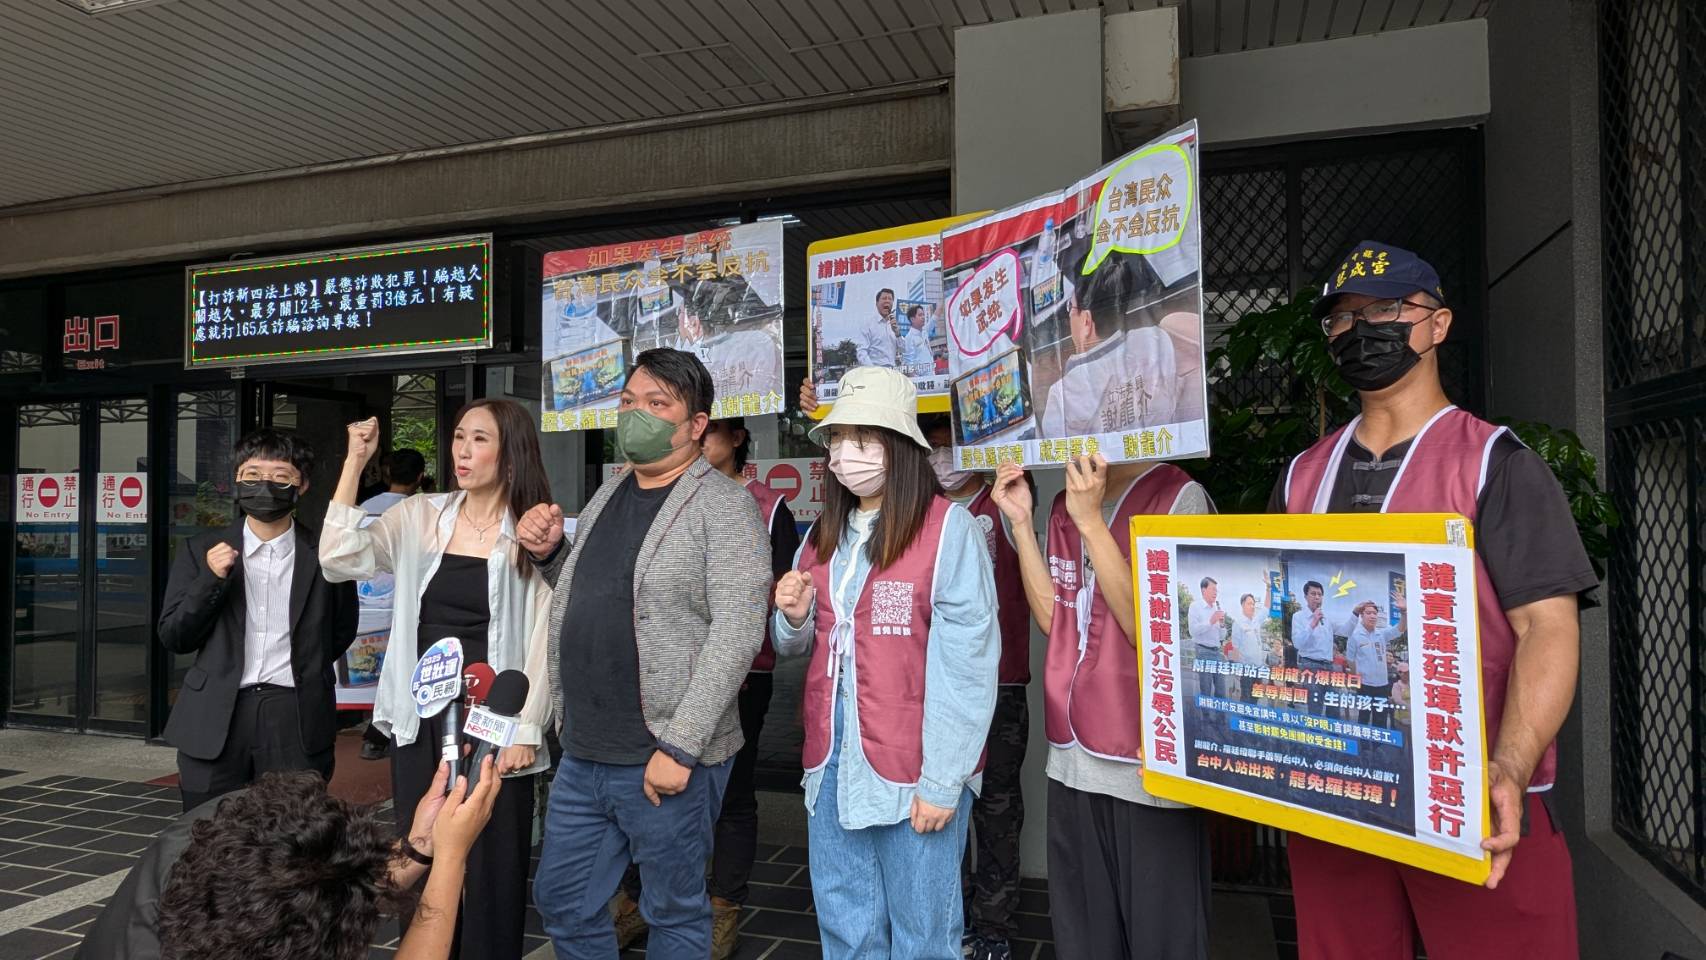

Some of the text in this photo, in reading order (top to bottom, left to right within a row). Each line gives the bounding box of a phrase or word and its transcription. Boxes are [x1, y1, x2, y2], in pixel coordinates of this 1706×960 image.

[1108, 173, 1173, 213] 台湾民众
[1096, 203, 1180, 244] 会不会反抗
[587, 231, 732, 269] 如果发生武统
[959, 267, 1010, 321] 如果发生
[63, 315, 120, 353] 出口
[976, 300, 1003, 335] 武统
[76, 358, 105, 370] Exit
[1122, 427, 1174, 459] 謝龍介
[21, 476, 35, 509] 通行
[63, 476, 77, 508] 禁止
[102, 475, 116, 509] 通行
[25, 511, 72, 520] No Entry
[107, 511, 121, 519] No
[1145, 548, 1178, 766] 譴責謝龍介污辱公民
[433, 680, 456, 698] 民視
[1417, 561, 1466, 839] 譴責羅廷瑋默許惡行
[466, 723, 492, 737] NEXT
